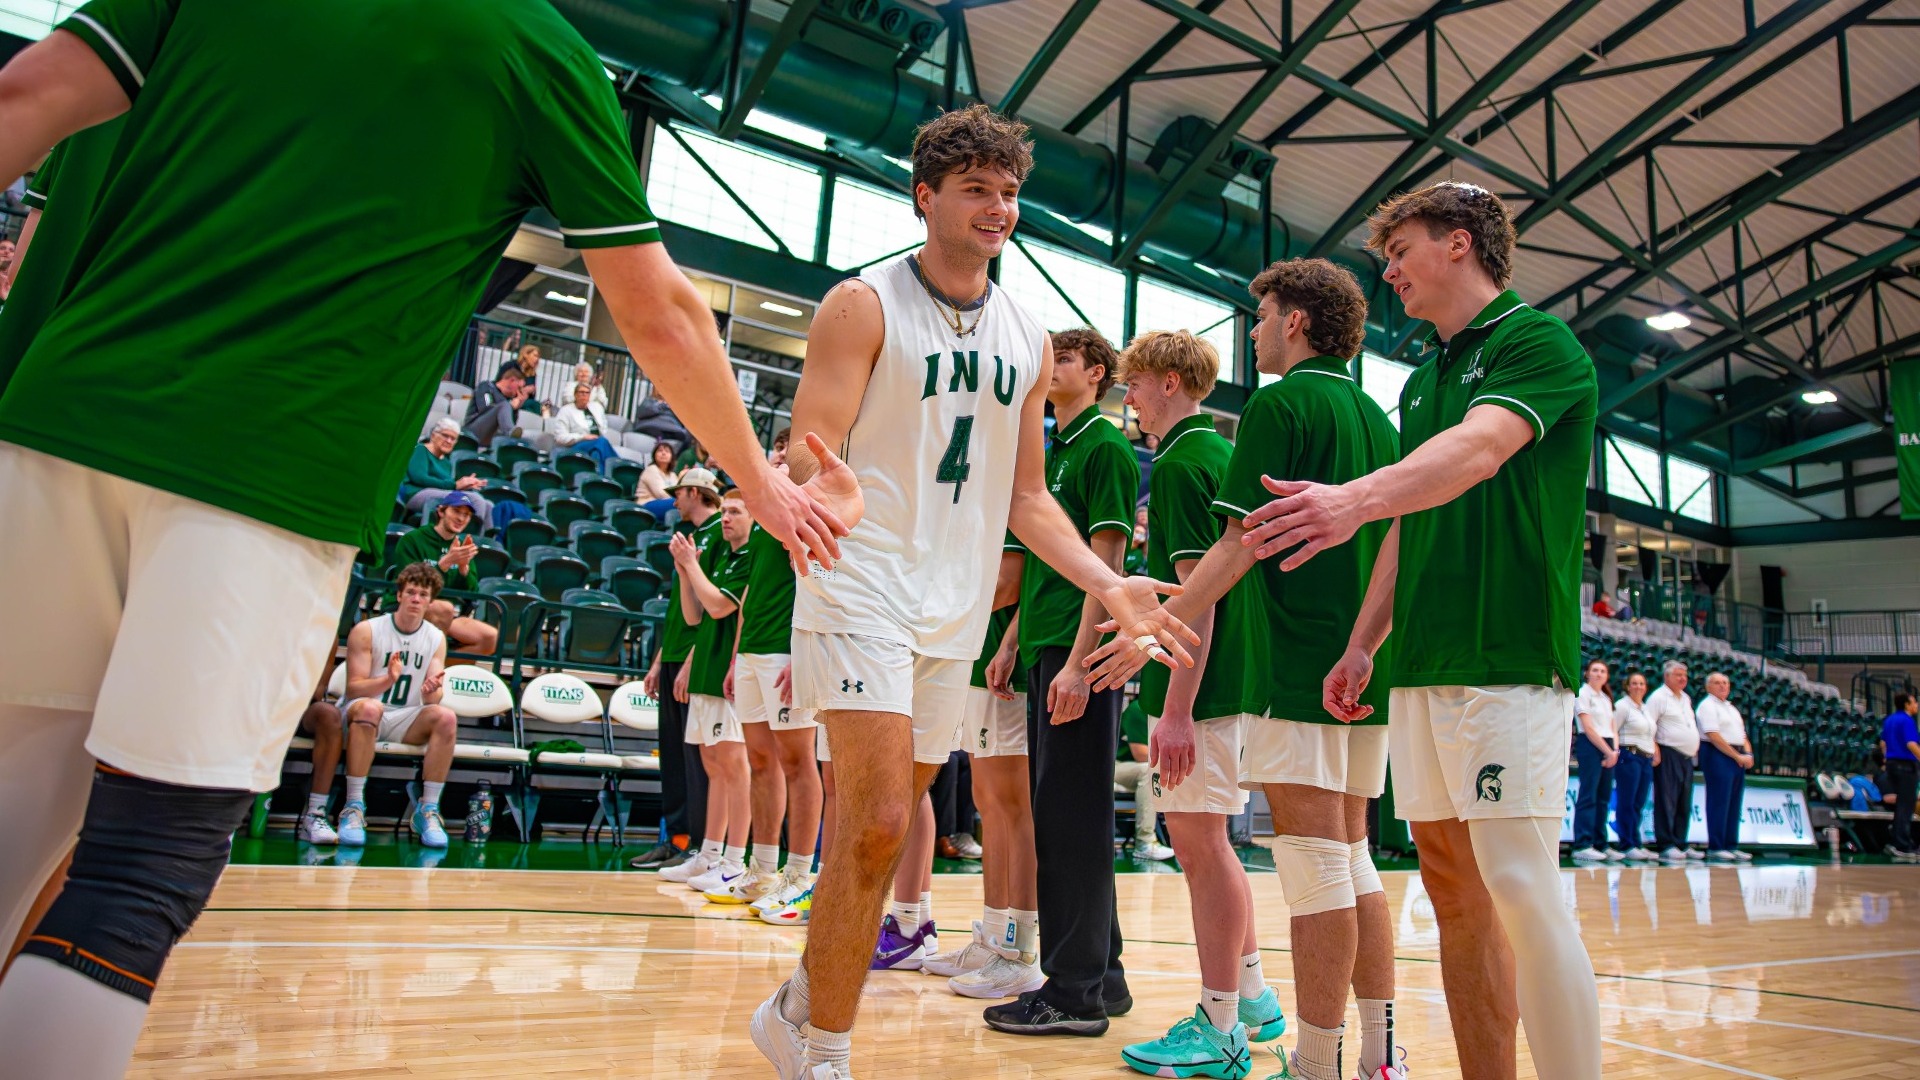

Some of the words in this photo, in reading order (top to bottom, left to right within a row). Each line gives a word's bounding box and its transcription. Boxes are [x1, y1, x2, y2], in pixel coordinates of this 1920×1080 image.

[1899, 432, 1920, 447] BA
[936, 415, 974, 504] 4
[450, 676, 493, 694] TITANS
[541, 685, 584, 701] TITANS
[1746, 806, 1785, 826] TITANS
